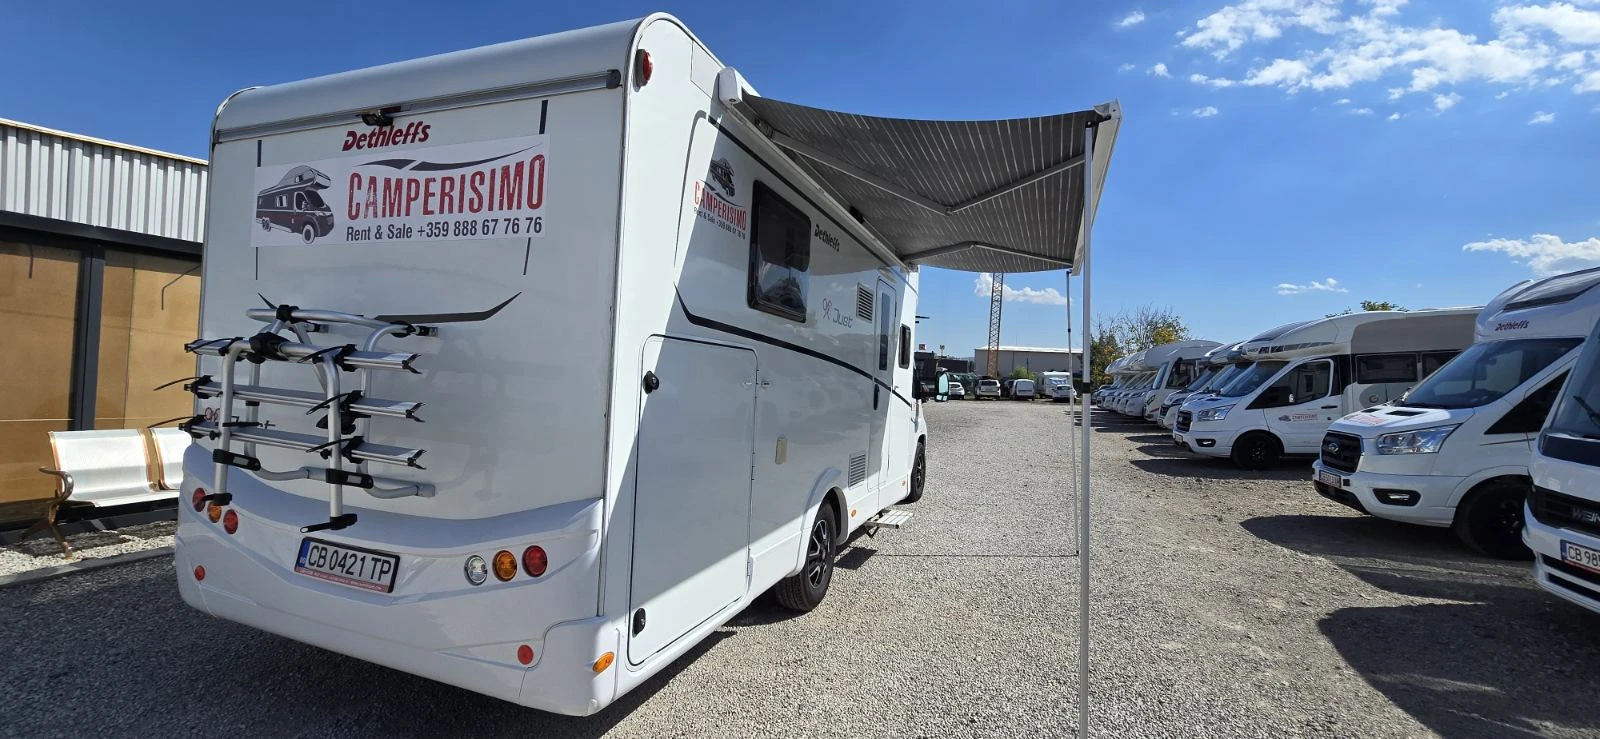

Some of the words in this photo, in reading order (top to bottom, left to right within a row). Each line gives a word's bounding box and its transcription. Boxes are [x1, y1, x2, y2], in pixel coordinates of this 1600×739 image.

[342, 120, 431, 152] Dethleffs
[346, 153, 546, 221] CAMPERISIMO
[694, 181, 747, 231] CAMPERISIMO
[346, 226, 371, 242] Rent
[374, 225, 383, 240] &
[387, 224, 413, 240] Sale
[417, 220, 449, 238] +359
[453, 219, 478, 237] 888
[481, 218, 499, 236] 67
[503, 217, 521, 235] 76
[525, 216, 543, 234] 76
[832, 307, 853, 329] Just
[308, 545, 328, 569] CB
[329, 550, 367, 577] 0421
[371, 557, 392, 581] TP
[1568, 546, 1583, 562] CB
